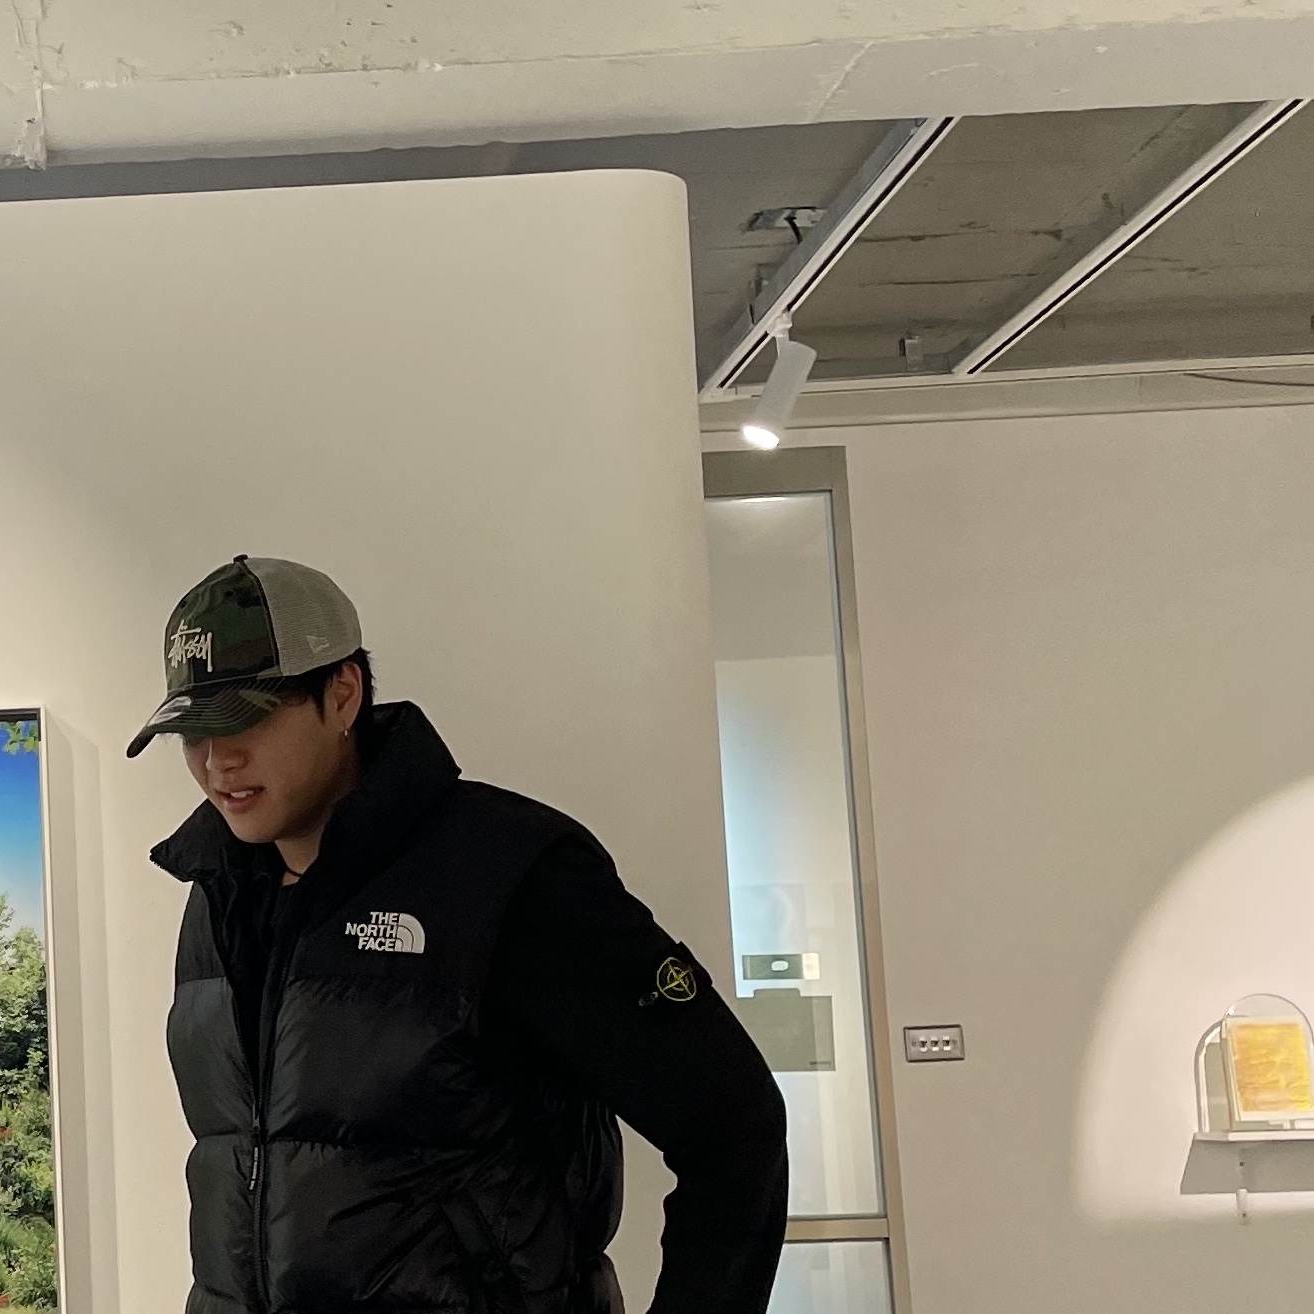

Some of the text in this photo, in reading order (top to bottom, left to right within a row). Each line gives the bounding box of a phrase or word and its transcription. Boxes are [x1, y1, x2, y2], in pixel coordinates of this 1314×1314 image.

[370, 911, 399, 925] THE
[345, 922, 397, 938] NORTH
[358, 936, 395, 952] FACE
